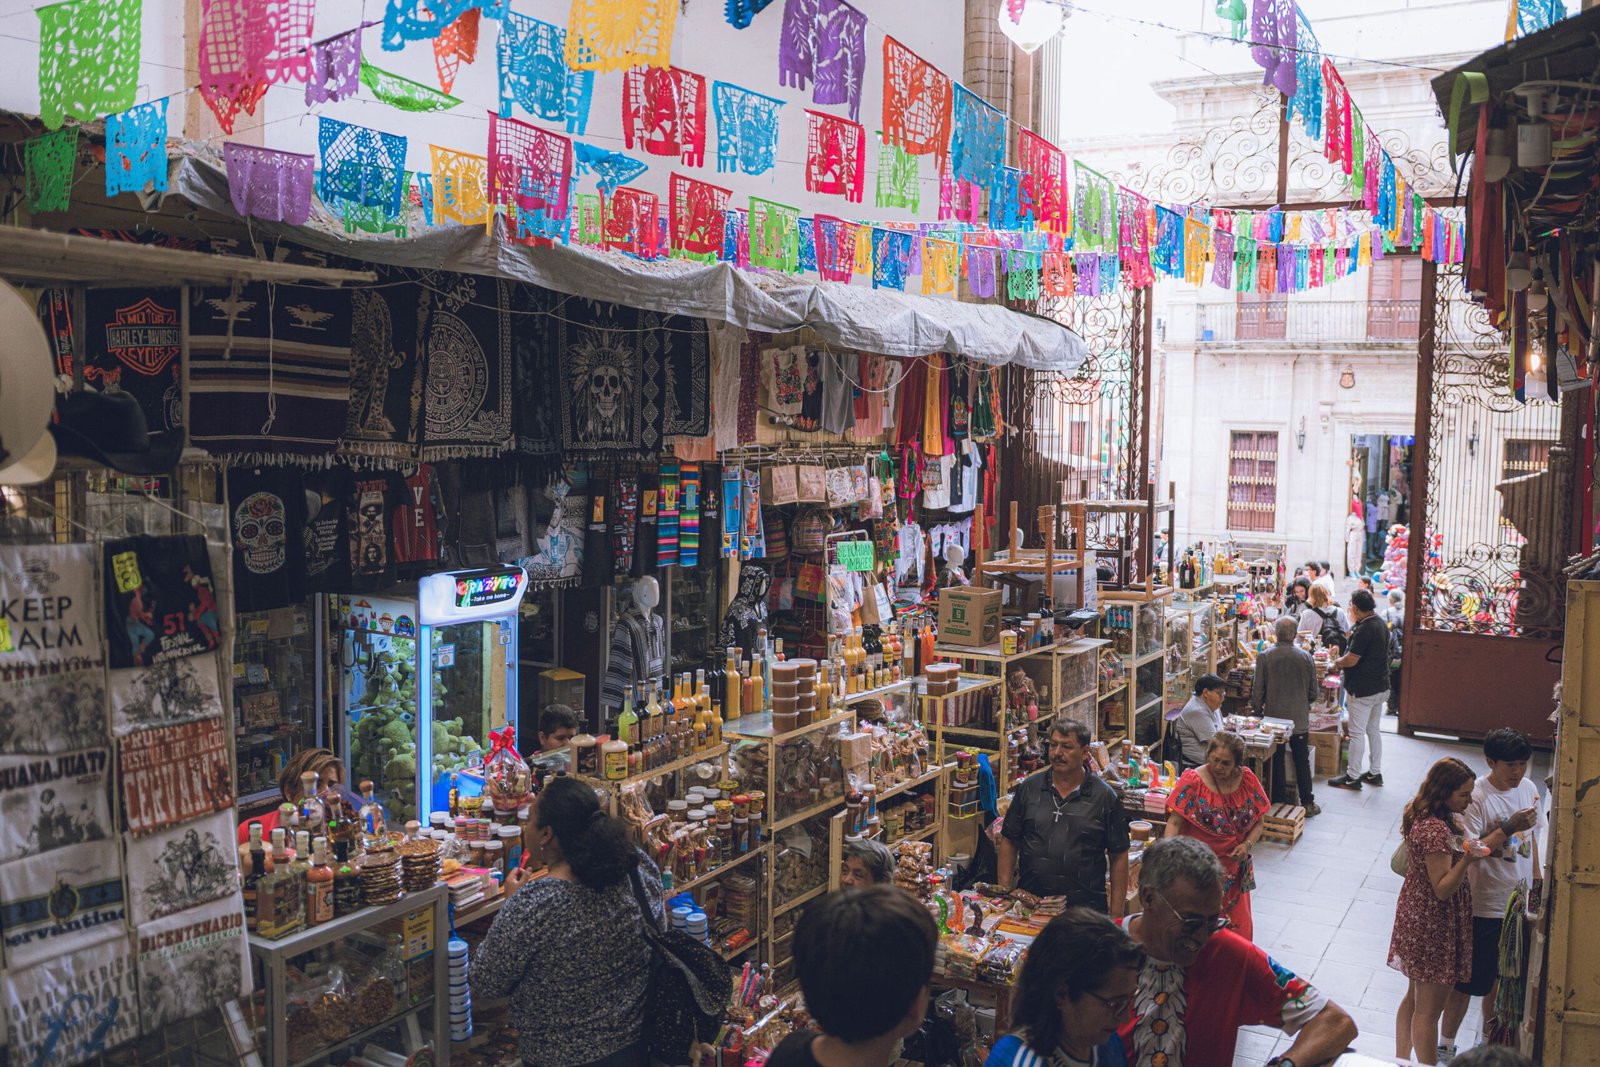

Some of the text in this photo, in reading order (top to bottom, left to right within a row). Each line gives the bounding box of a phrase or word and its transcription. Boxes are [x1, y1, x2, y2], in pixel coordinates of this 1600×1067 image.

[127, 309, 165, 325] MOTOR
[110, 327, 181, 347] HARLEY-DAVIDSO
[126, 346, 165, 368] CYCLES
[1, 596, 72, 622] KEEP
[18, 622, 83, 650] ALM
[163, 611, 186, 636] 51
[0, 750, 106, 794] UANAJUATO
[140, 912, 243, 954] BICENTENARIO
